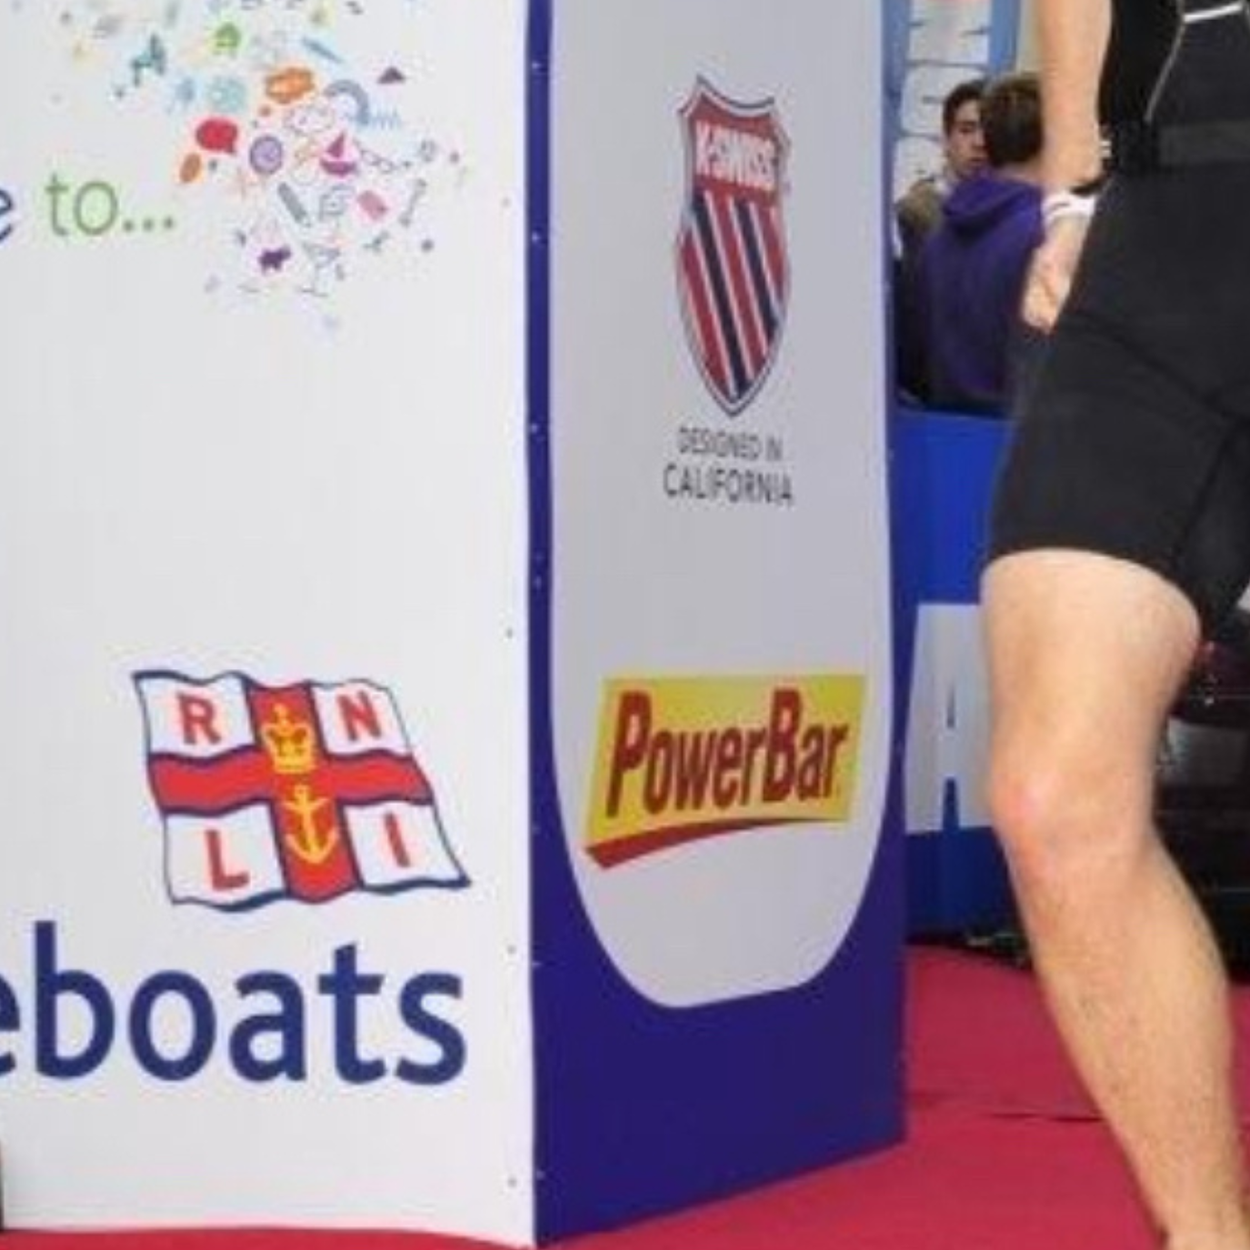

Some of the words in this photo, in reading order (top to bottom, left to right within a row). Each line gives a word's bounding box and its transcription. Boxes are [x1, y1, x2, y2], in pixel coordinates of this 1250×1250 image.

[662, 462, 795, 508] CALIFORNIA
[678, 426, 763, 462] DESIGNED
[765, 433, 784, 463] IN
[606, 688, 850, 820] PowerBar
[0, 919, 467, 1086] boats
